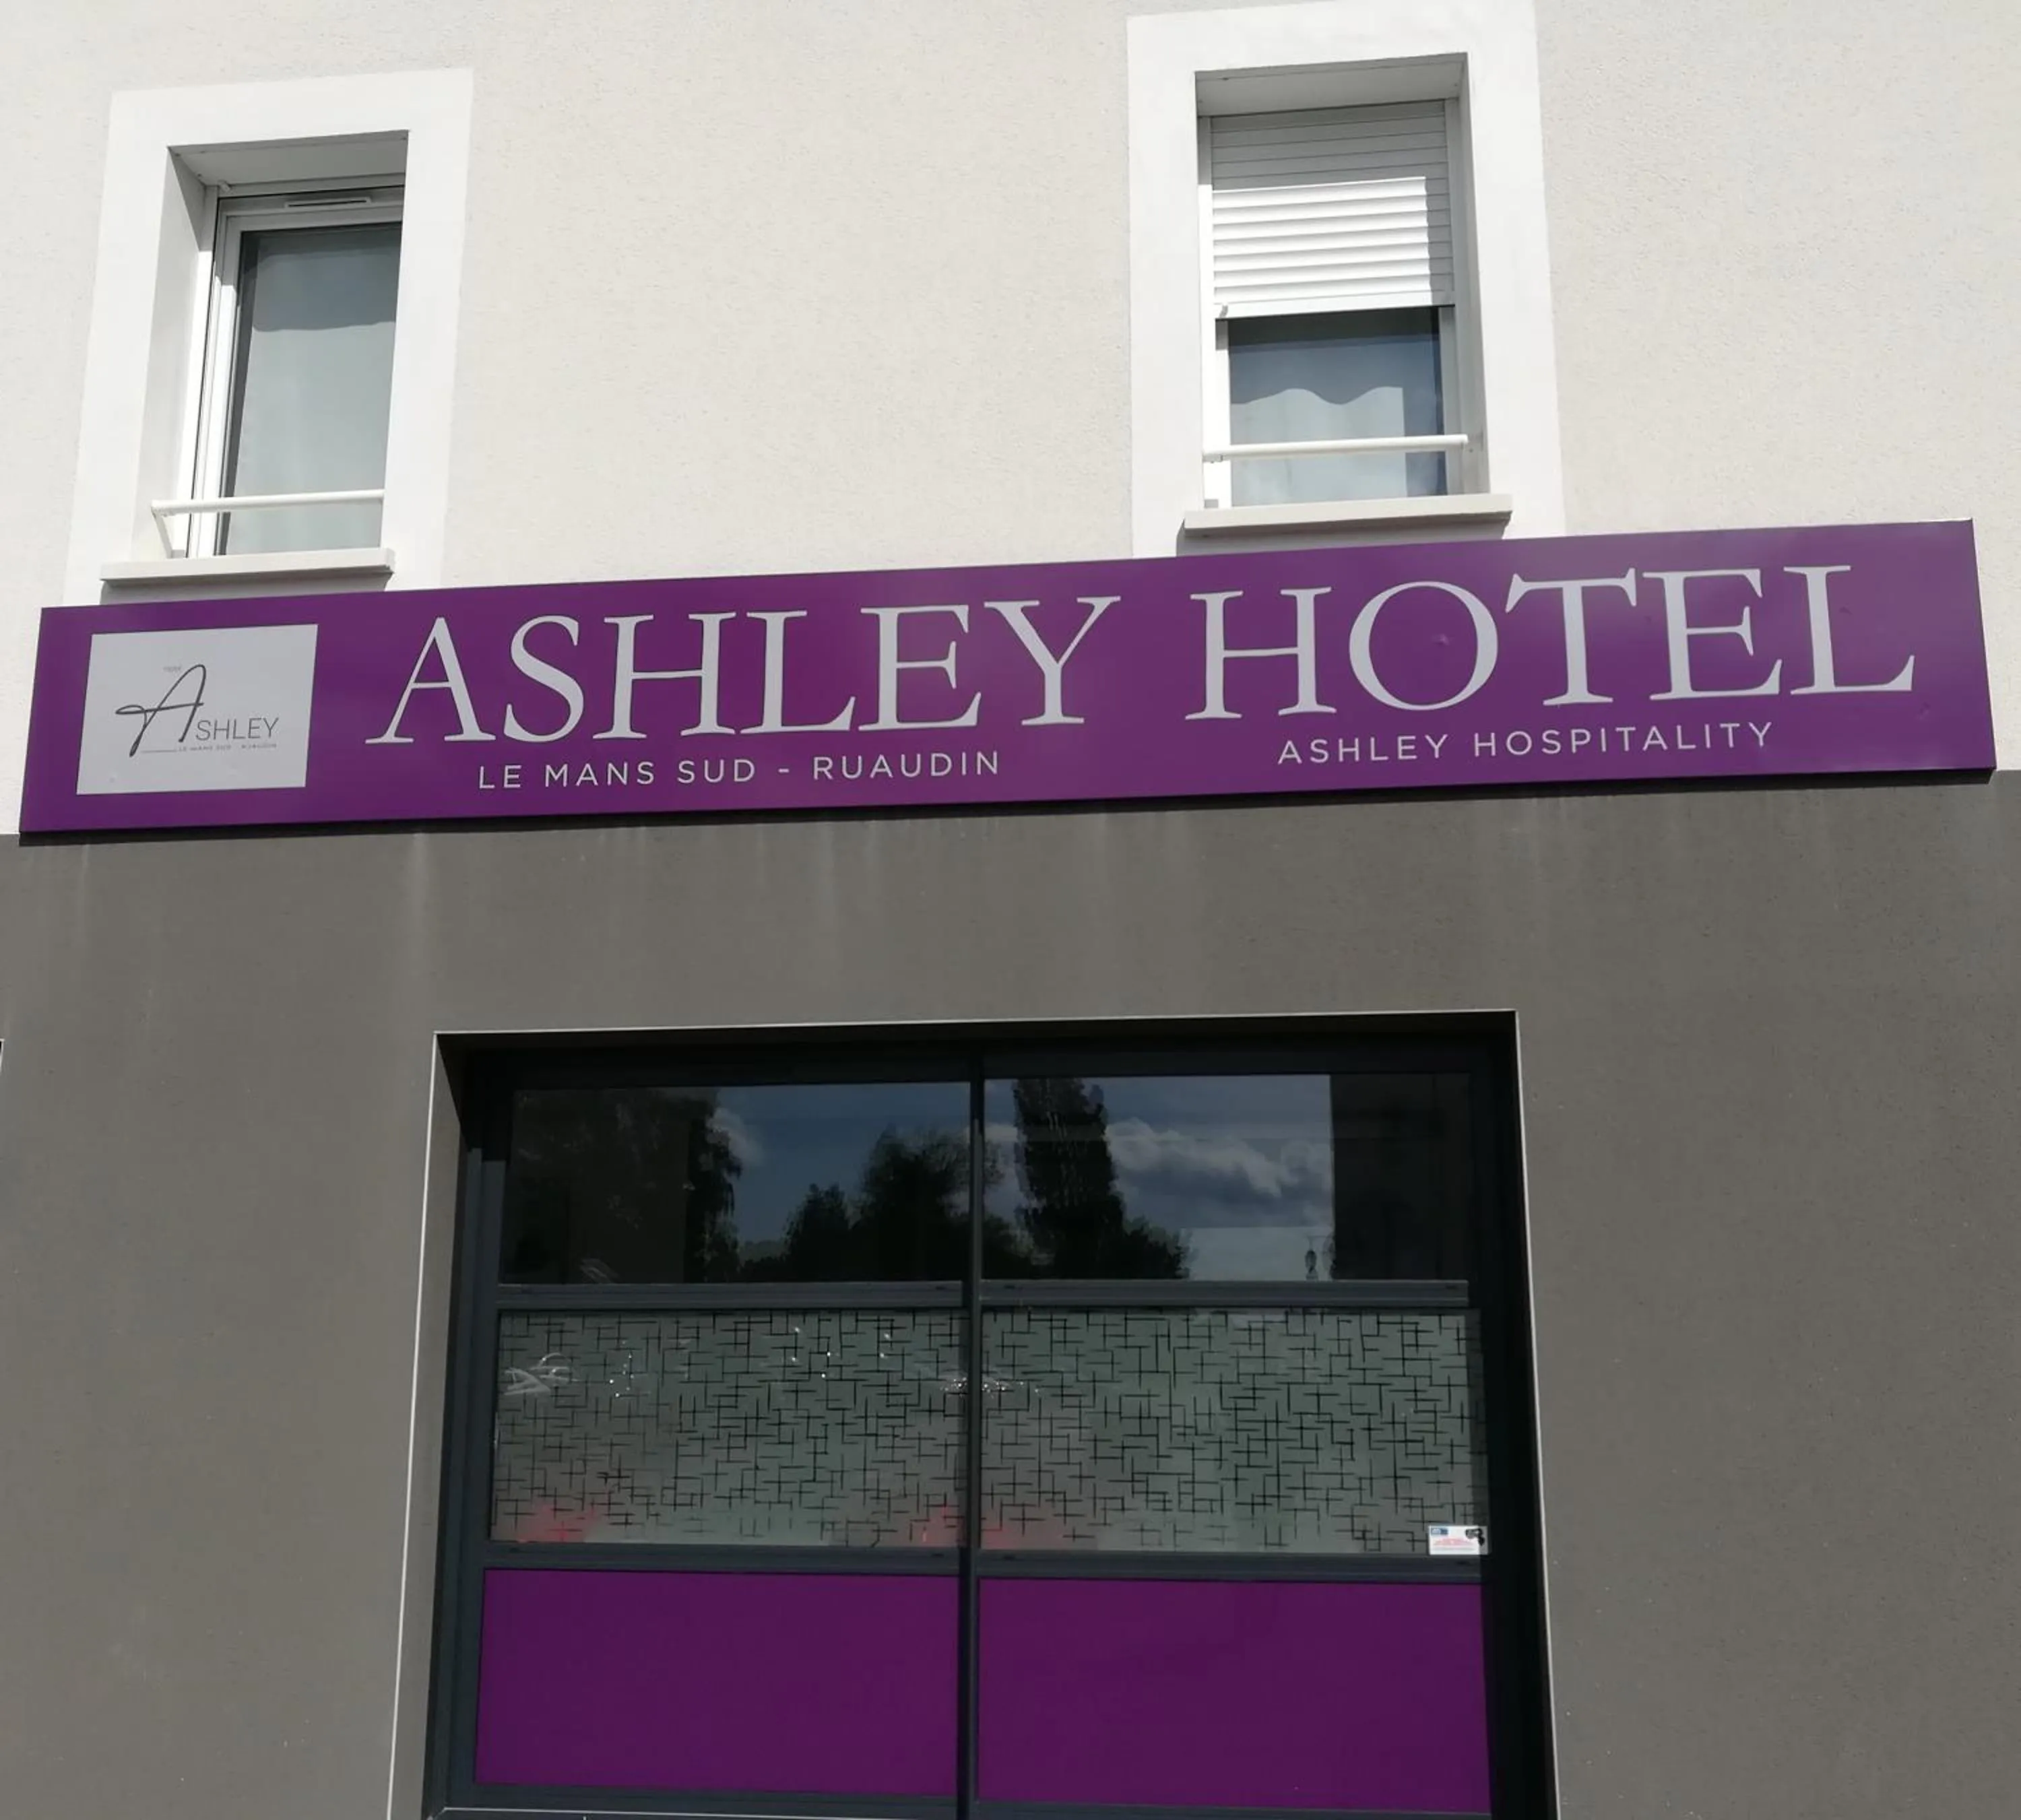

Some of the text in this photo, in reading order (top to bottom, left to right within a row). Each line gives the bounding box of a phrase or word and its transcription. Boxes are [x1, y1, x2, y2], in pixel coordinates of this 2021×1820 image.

[365, 564, 1915, 744] ASHLEY HOTEL
[115, 663, 280, 758] ASHLEY
[1277, 722, 1772, 764] ASHLEY HOSPITALITY
[478, 765, 521, 789] LE
[544, 762, 655, 787] MANS
[677, 759, 755, 783] SUD
[813, 752, 998, 780] RUAUDIN
